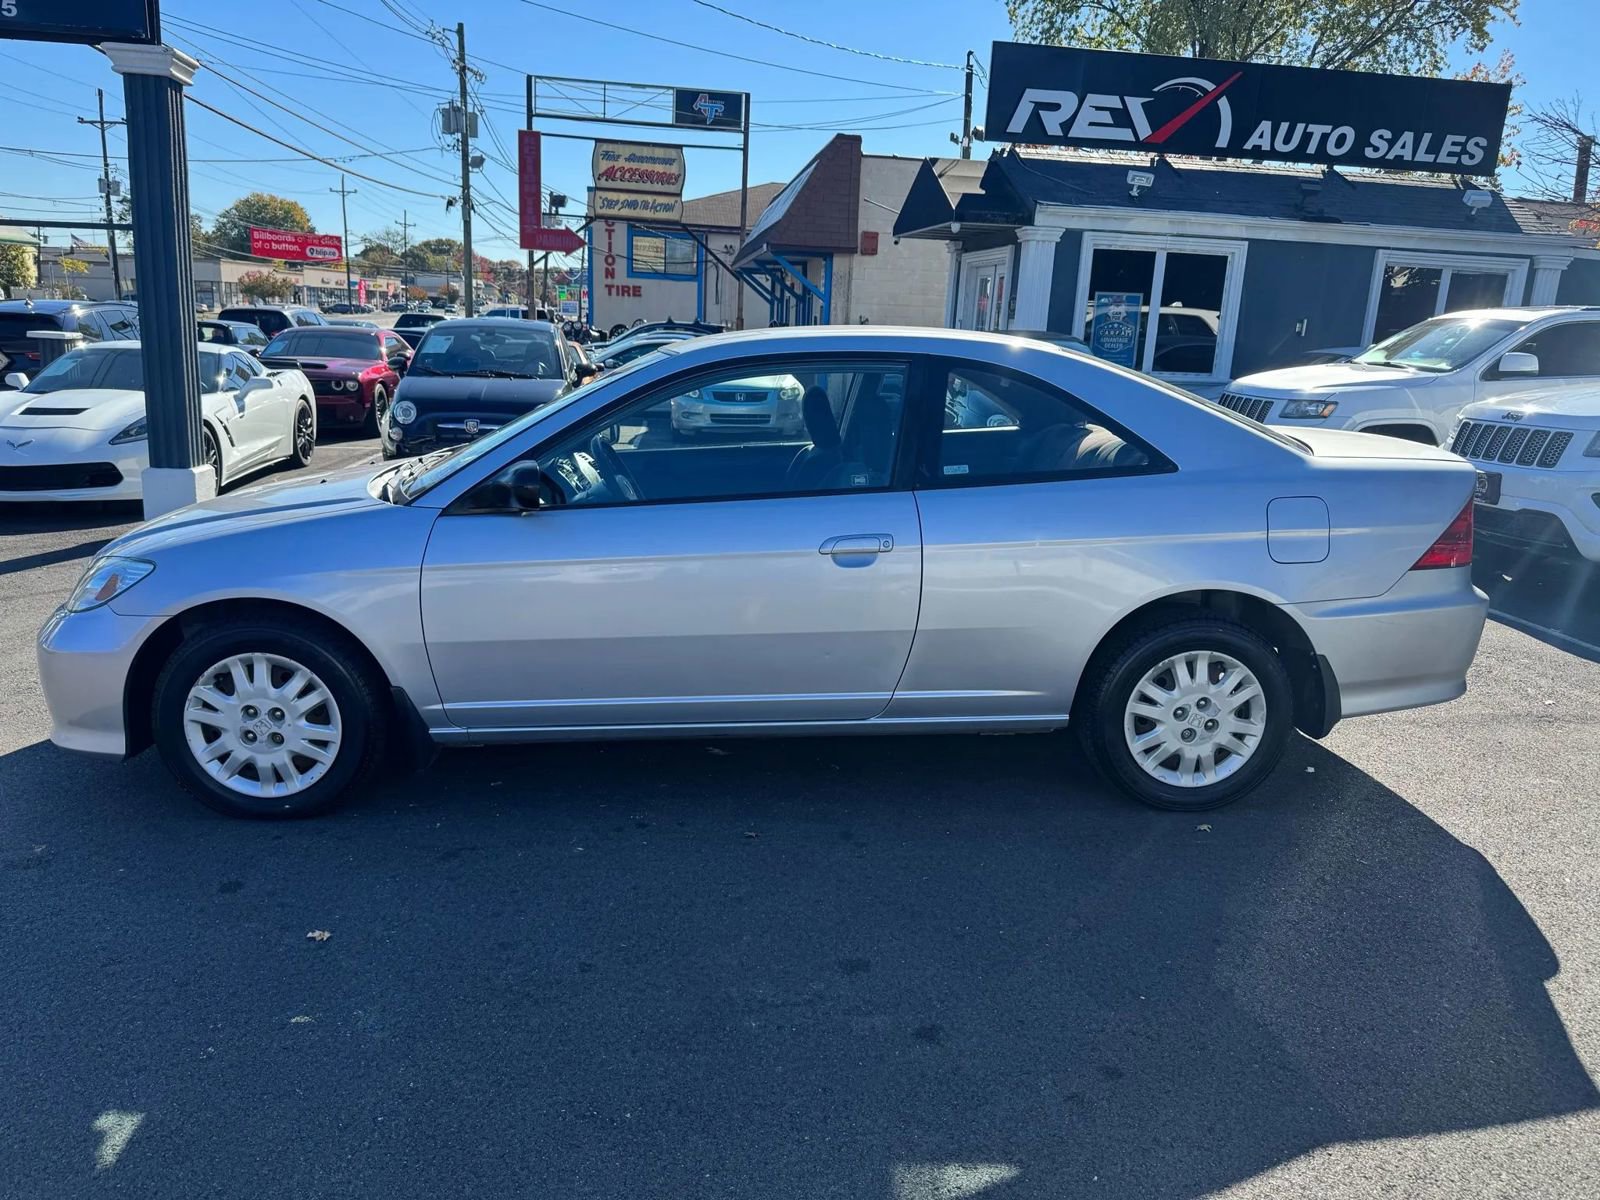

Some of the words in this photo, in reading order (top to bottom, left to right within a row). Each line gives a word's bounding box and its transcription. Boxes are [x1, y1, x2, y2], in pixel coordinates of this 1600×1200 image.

[1, 0, 18, 17] 5
[1006, 82, 1200, 143] REV
[1242, 120, 1356, 157] AUTO
[1364, 128, 1488, 166] SALES
[597, 165, 681, 186] ACCESSORIES
[253, 231, 296, 242] Billboards
[253, 240, 262, 249] of
[604, 284, 642, 297] TIRE
